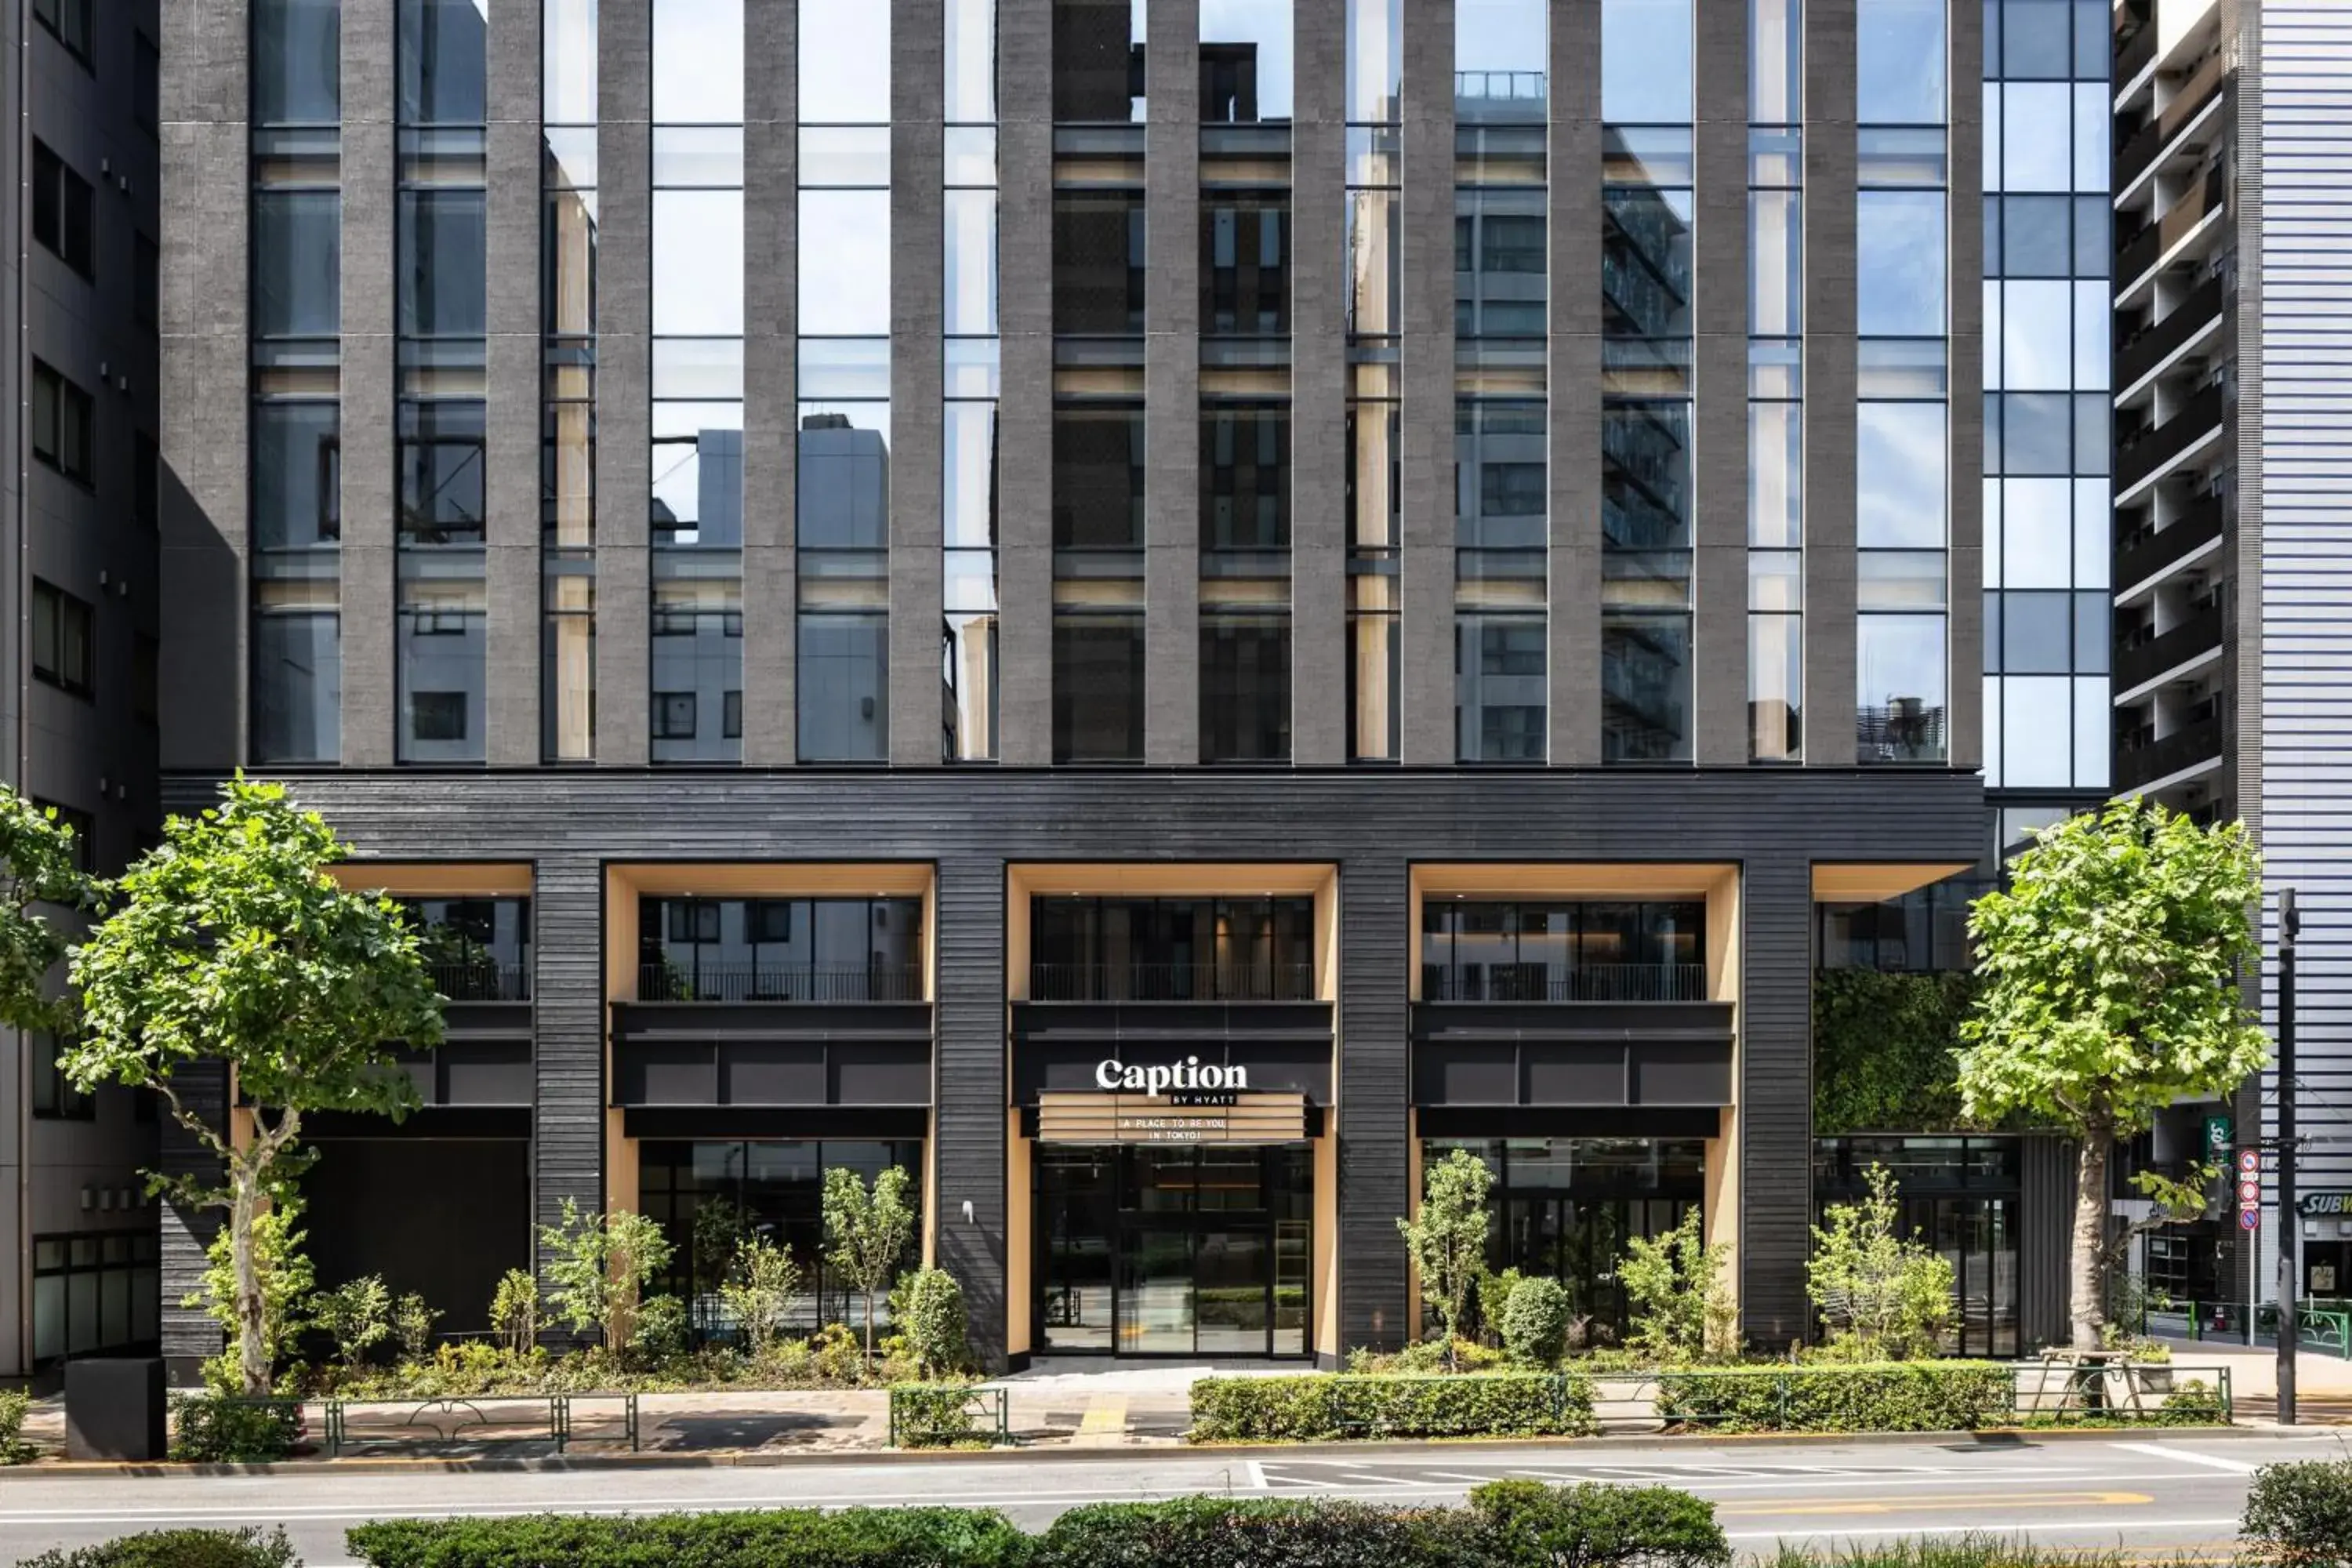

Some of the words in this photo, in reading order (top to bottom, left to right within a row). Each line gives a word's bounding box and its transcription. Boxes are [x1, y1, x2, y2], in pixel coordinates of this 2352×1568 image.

[1095, 1056, 1248, 1097] Caption
[1173, 1095, 1188, 1105] BY
[1194, 1095, 1235, 1105] HYATT
[1123, 1119, 1130, 1127] A
[1136, 1119, 1166, 1127] PLACE
[1173, 1119, 1185, 1127] TO
[1189, 1119, 1202, 1127] BE
